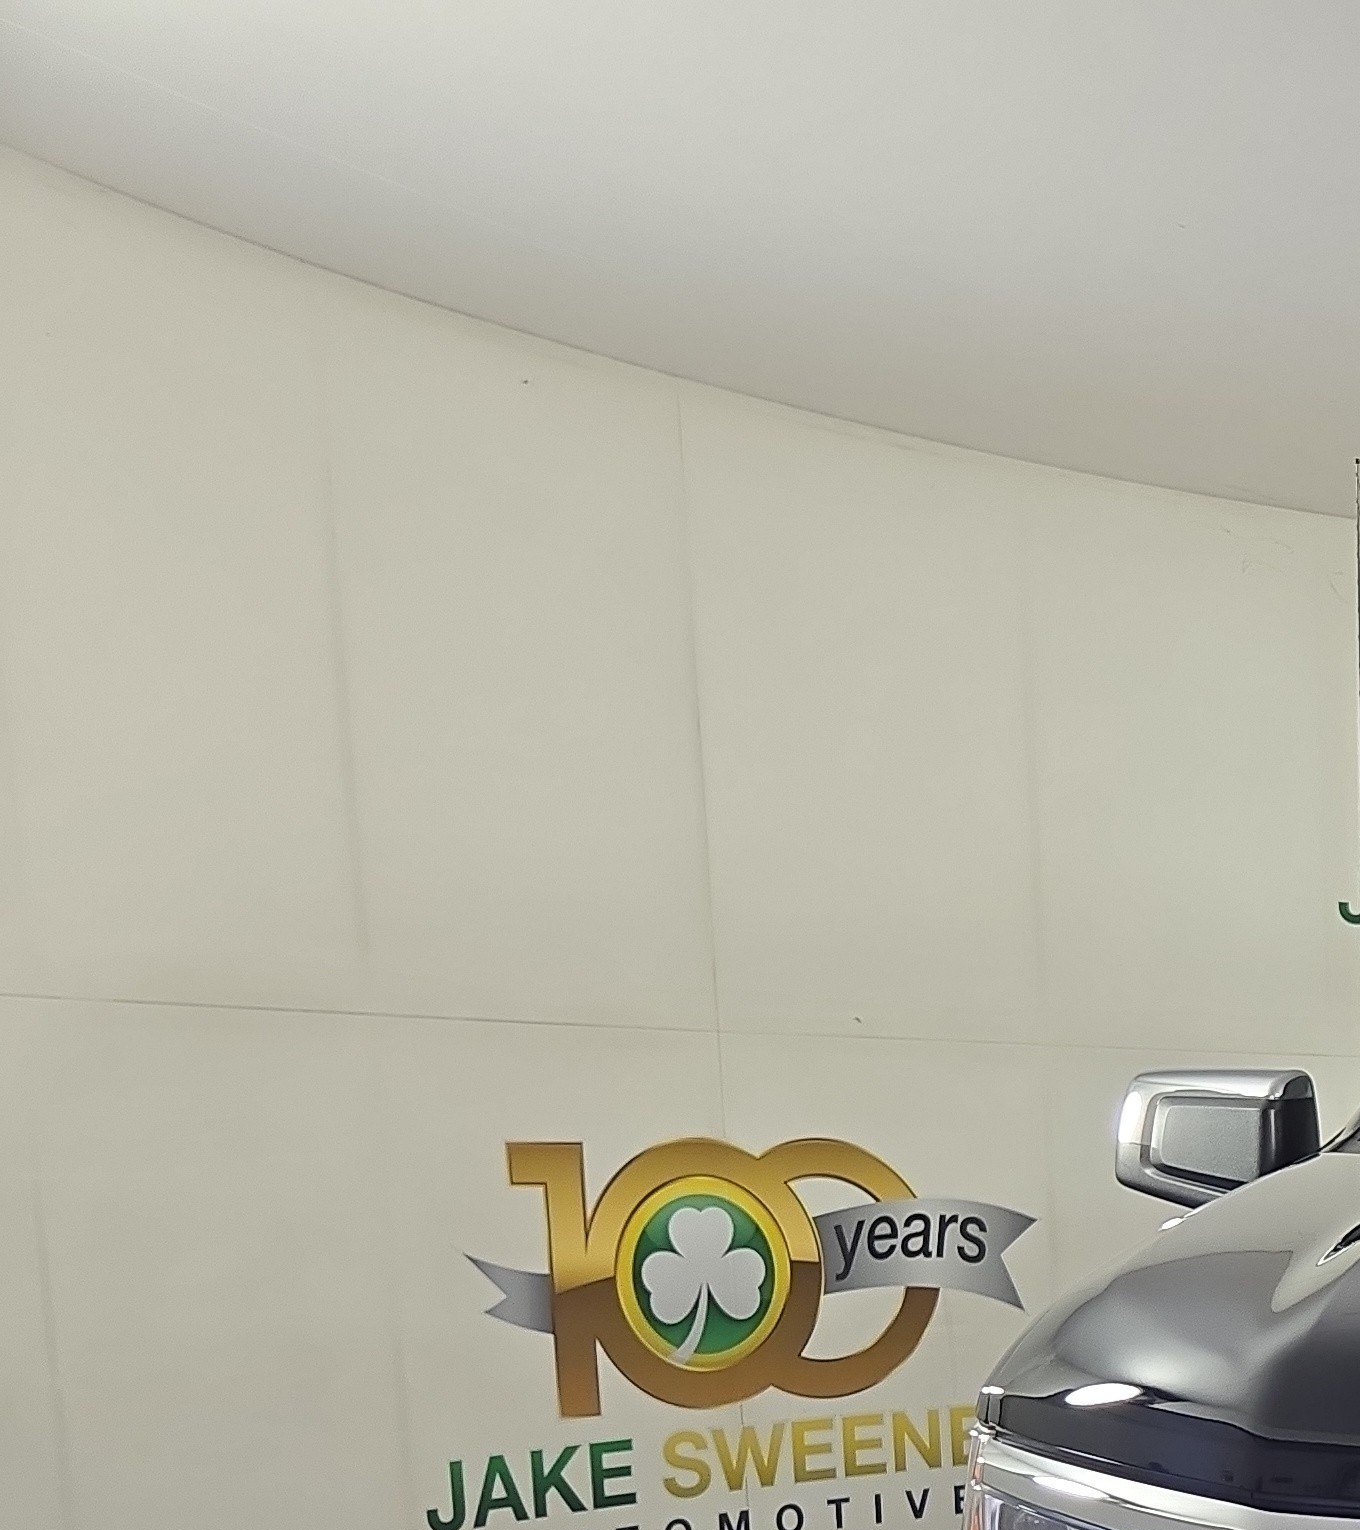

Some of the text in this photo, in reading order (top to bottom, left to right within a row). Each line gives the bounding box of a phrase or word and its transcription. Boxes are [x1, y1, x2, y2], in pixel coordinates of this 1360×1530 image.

[505, 1137, 941, 1420] 100
[834, 1209, 988, 1281] years
[662, 1404, 977, 1498] SWEENE
